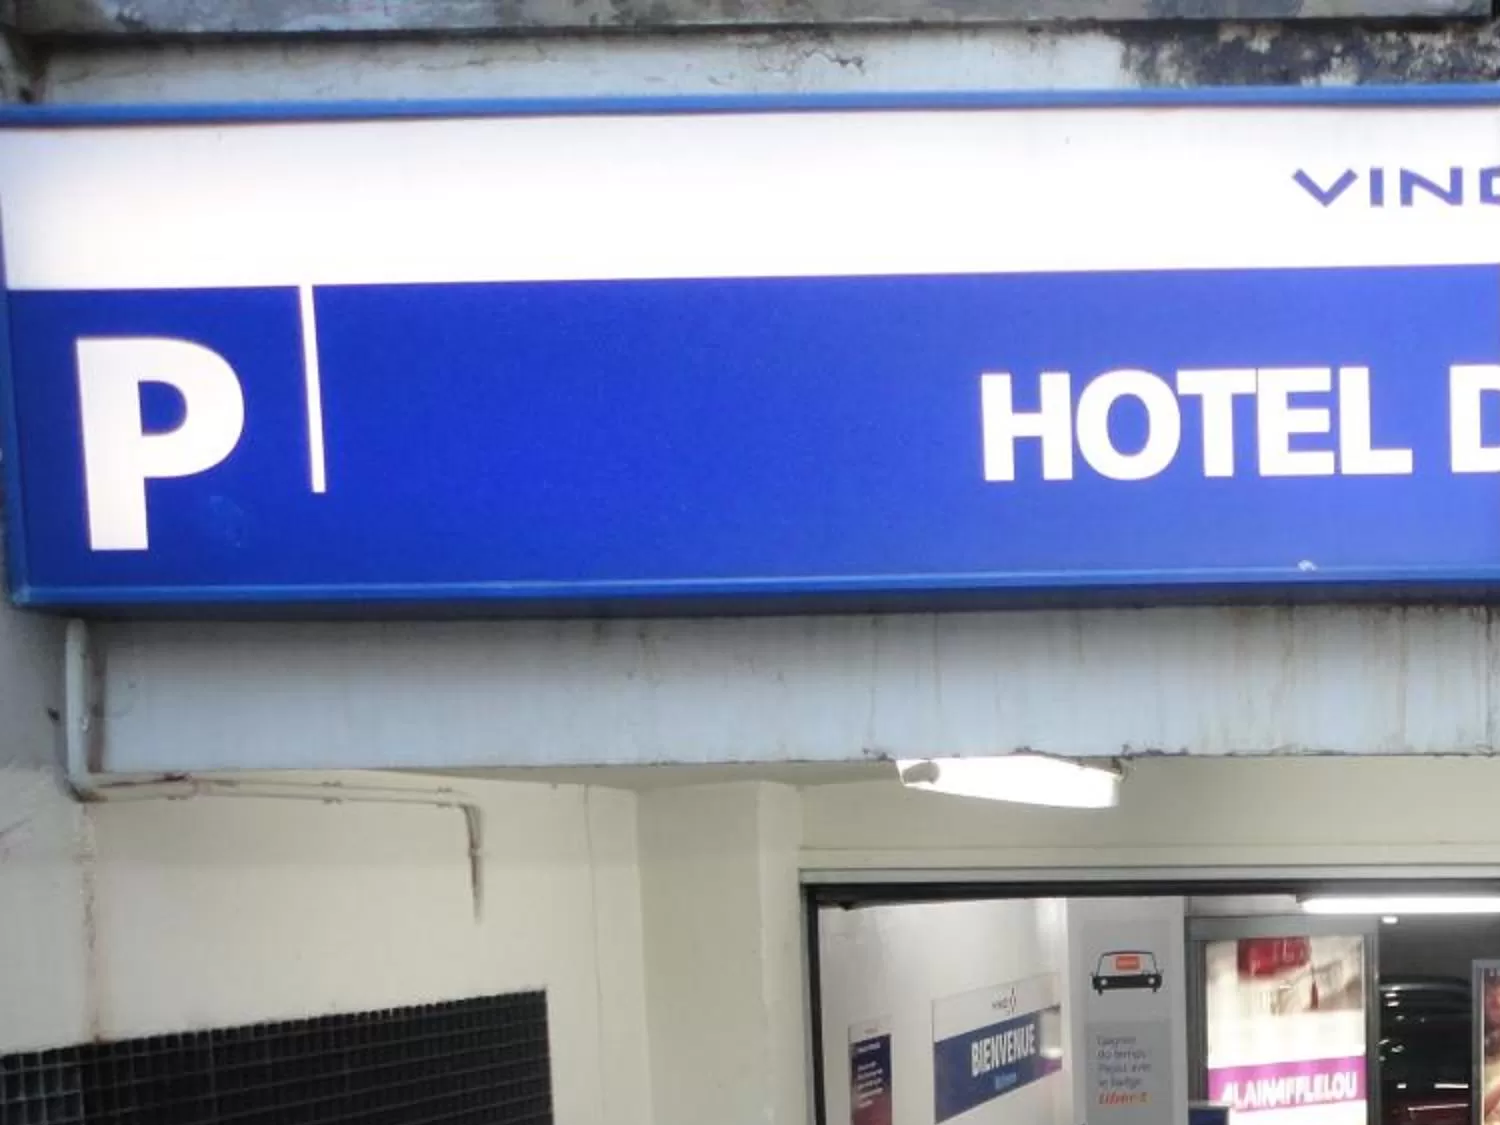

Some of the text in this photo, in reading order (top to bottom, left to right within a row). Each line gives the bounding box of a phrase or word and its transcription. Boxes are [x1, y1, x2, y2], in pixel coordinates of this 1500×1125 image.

[76, 337, 245, 551] P
[981, 366, 1413, 481] HOTEL
[970, 1023, 1036, 1077] BIENVENUE
